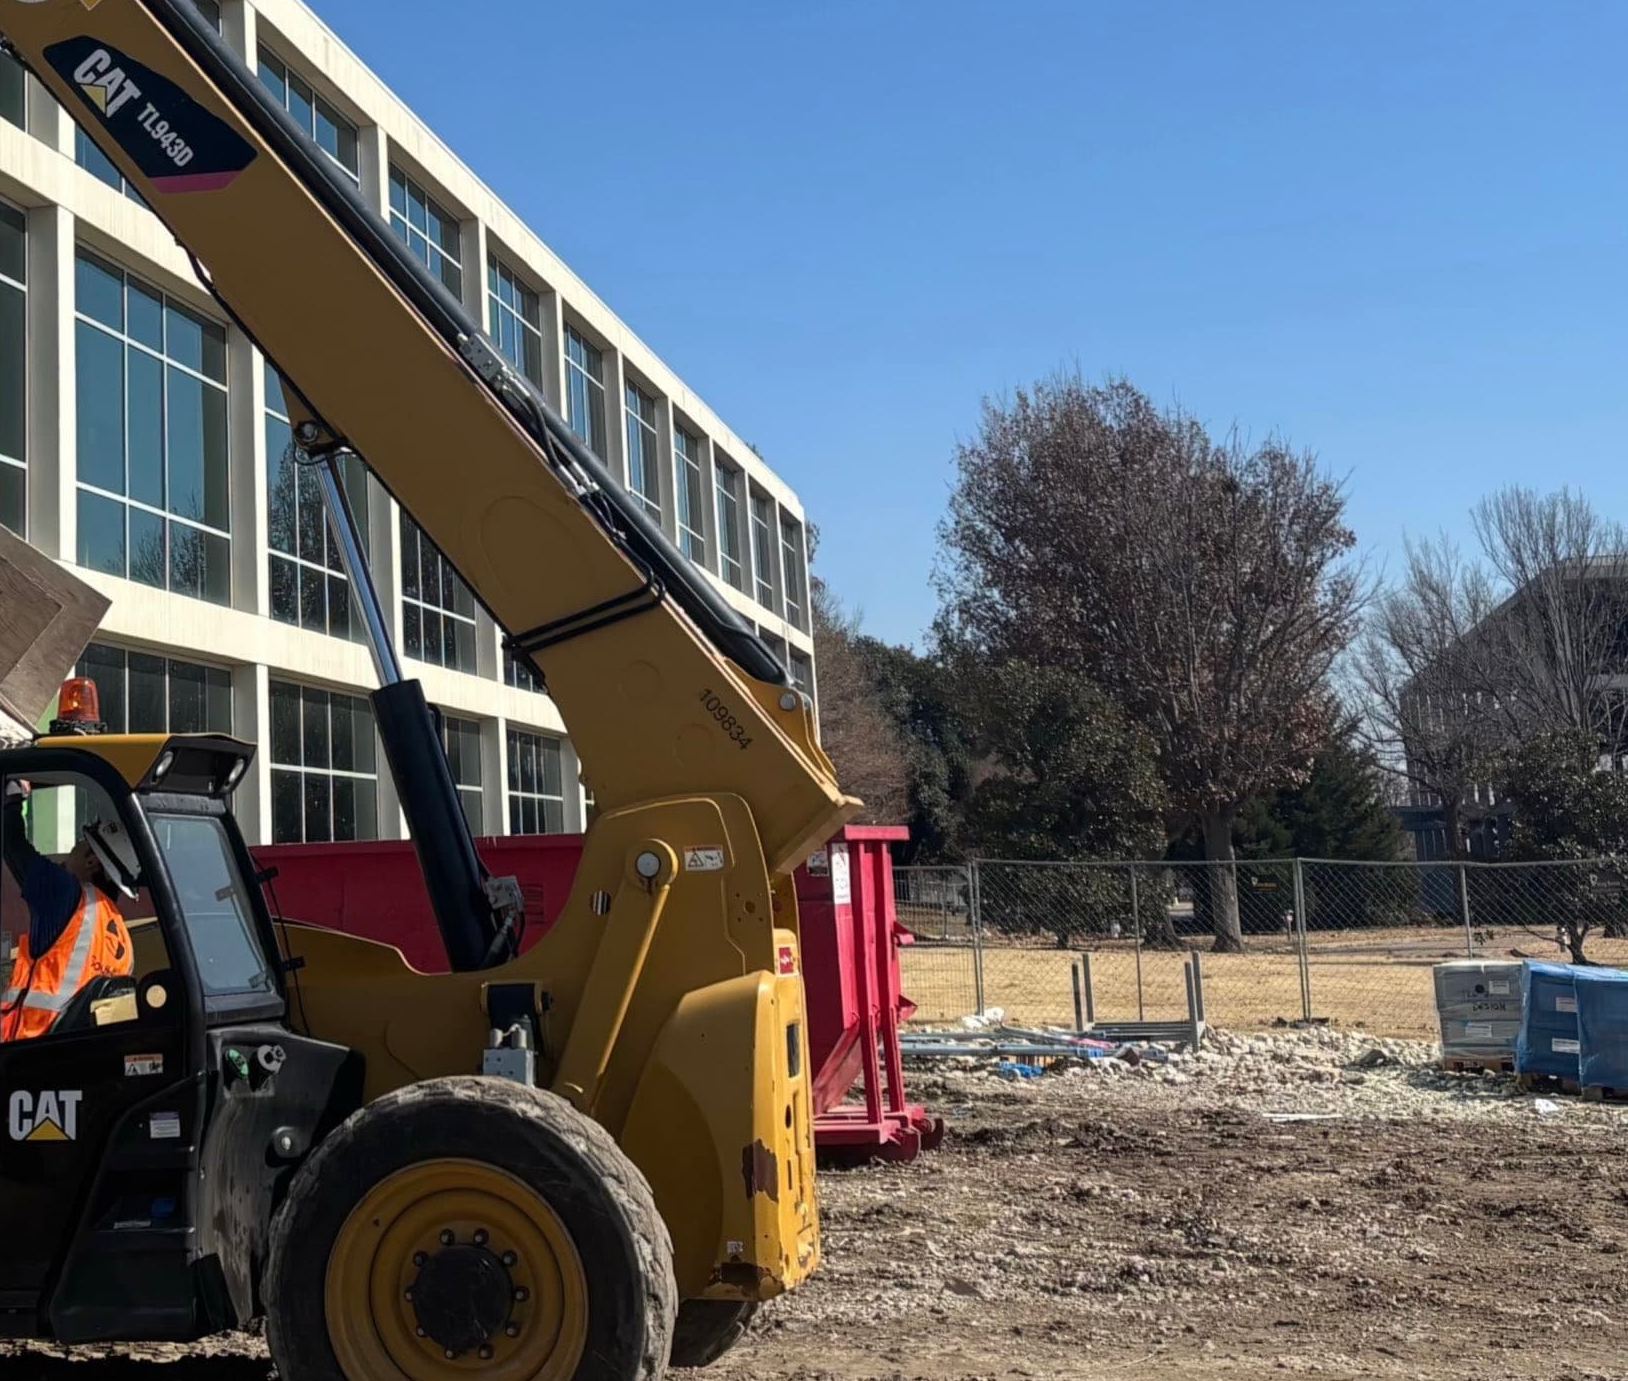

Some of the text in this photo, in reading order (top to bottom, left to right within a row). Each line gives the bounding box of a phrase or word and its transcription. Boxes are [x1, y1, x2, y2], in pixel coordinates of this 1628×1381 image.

[73, 48, 195, 167] CAT TL943D
[699, 687, 754, 751] 109834
[8, 1090, 83, 1141] CAT
